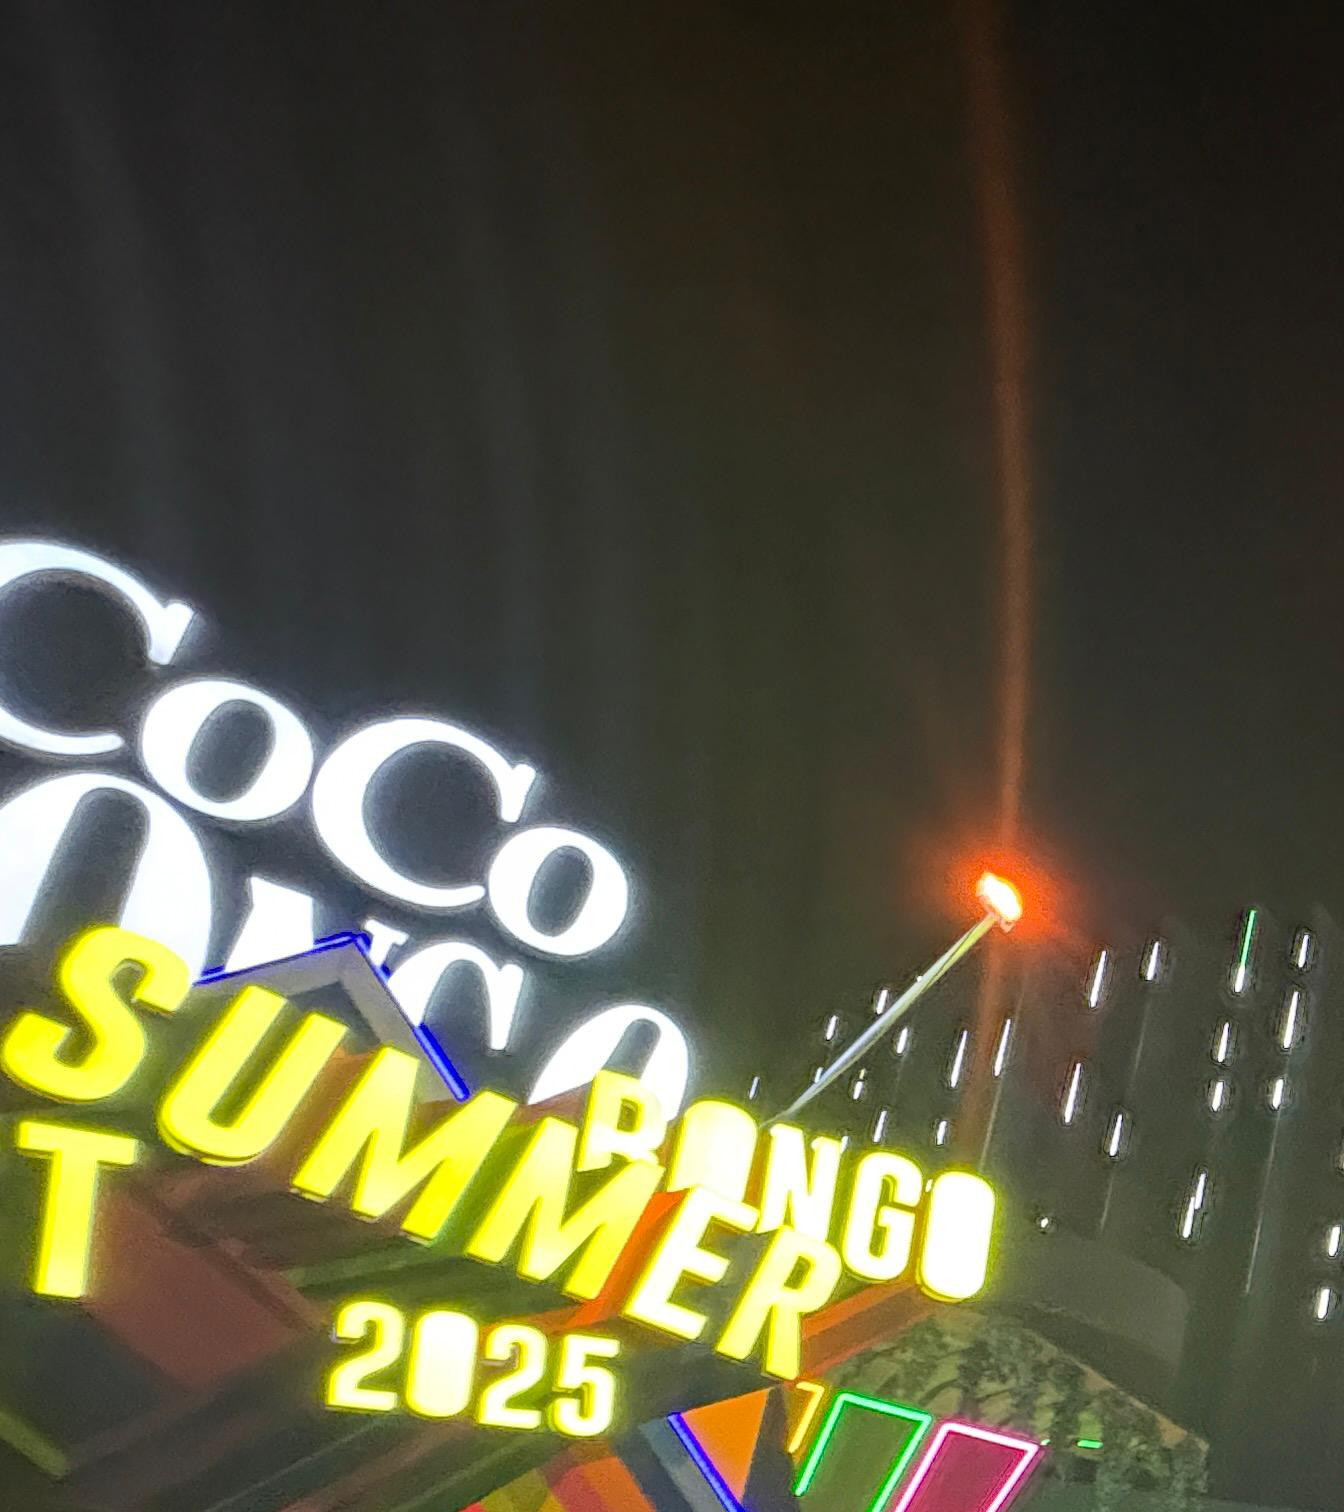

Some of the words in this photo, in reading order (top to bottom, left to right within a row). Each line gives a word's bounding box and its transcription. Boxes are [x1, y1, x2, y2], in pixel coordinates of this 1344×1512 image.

[2, 924, 843, 1382] SUMMER
[575, 1068, 997, 1303] BONGO
[326, 1299, 621, 1439] 2025
